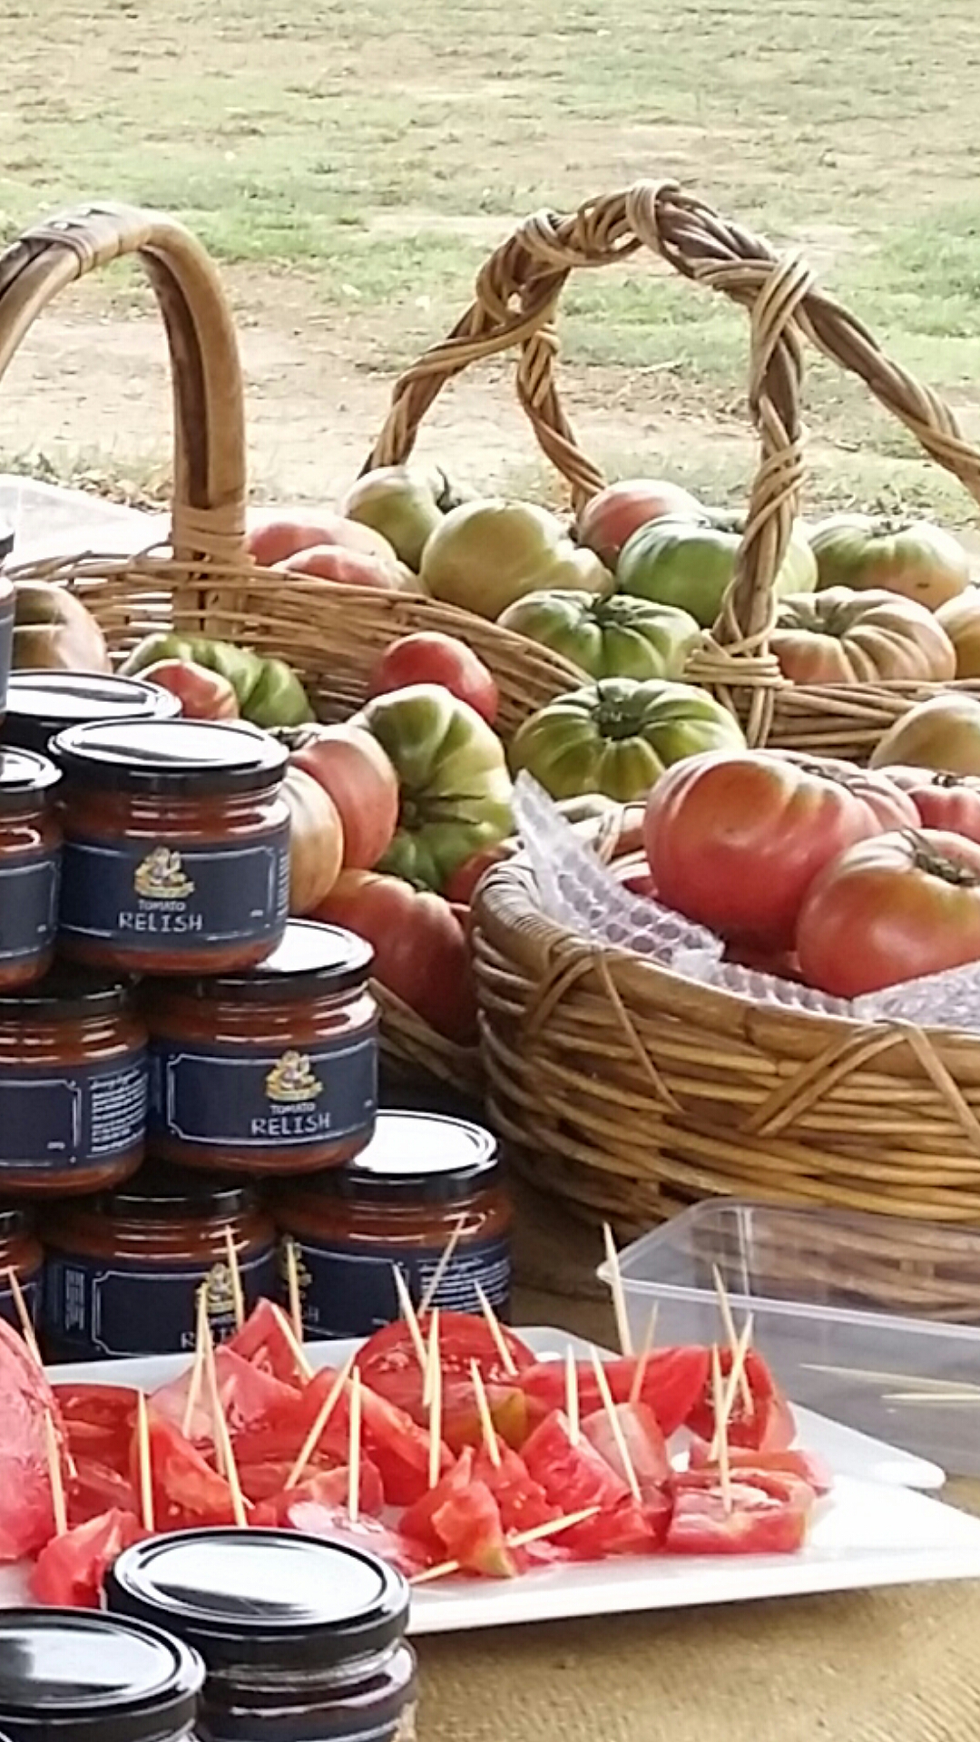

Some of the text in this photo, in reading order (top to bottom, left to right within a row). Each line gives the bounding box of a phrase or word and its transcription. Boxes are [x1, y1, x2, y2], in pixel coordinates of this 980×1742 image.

[138, 900, 186, 911] TOMATO
[118, 912, 203, 932] RELISH
[270, 1102, 316, 1115] TOMATO
[251, 1113, 331, 1136] RELISH
